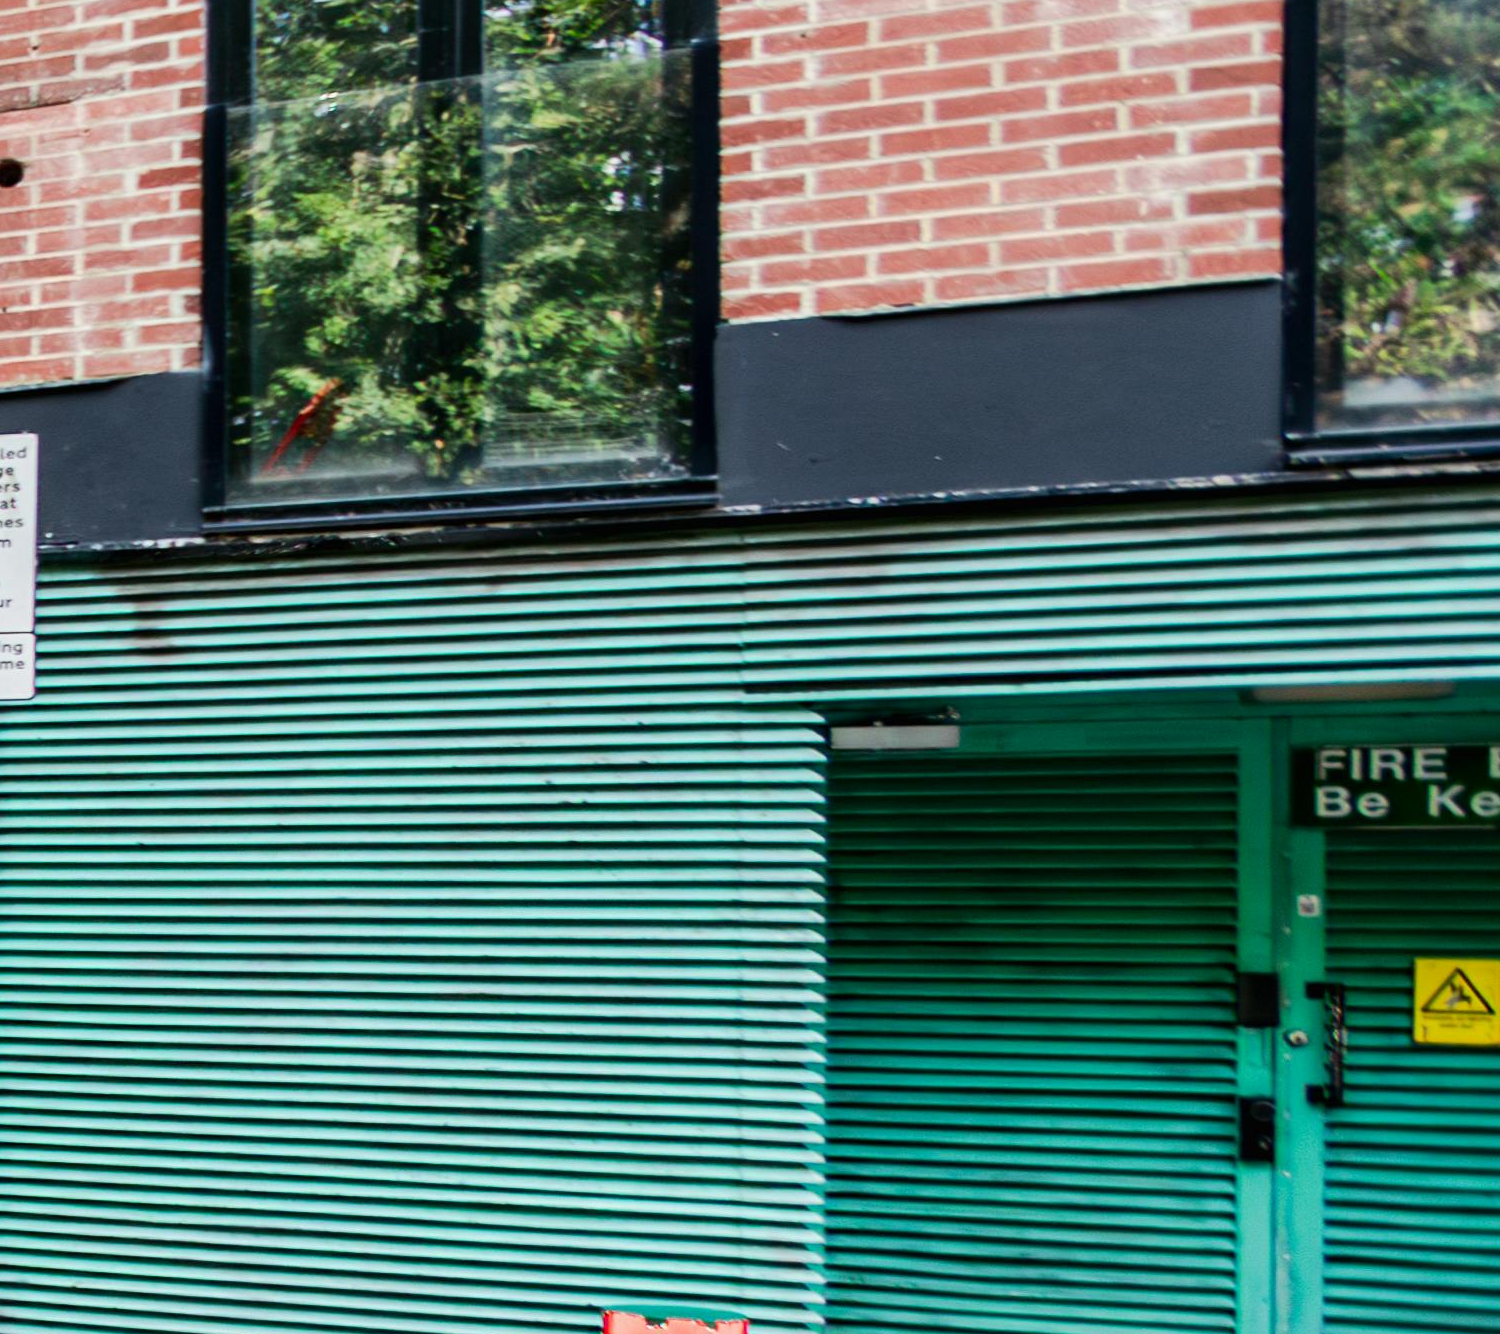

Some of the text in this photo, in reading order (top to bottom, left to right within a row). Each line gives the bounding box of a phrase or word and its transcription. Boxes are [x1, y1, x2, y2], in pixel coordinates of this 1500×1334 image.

[0, 498, 18, 510] at
[1316, 747, 1448, 780] FIRE
[1315, 785, 1389, 818] Be
